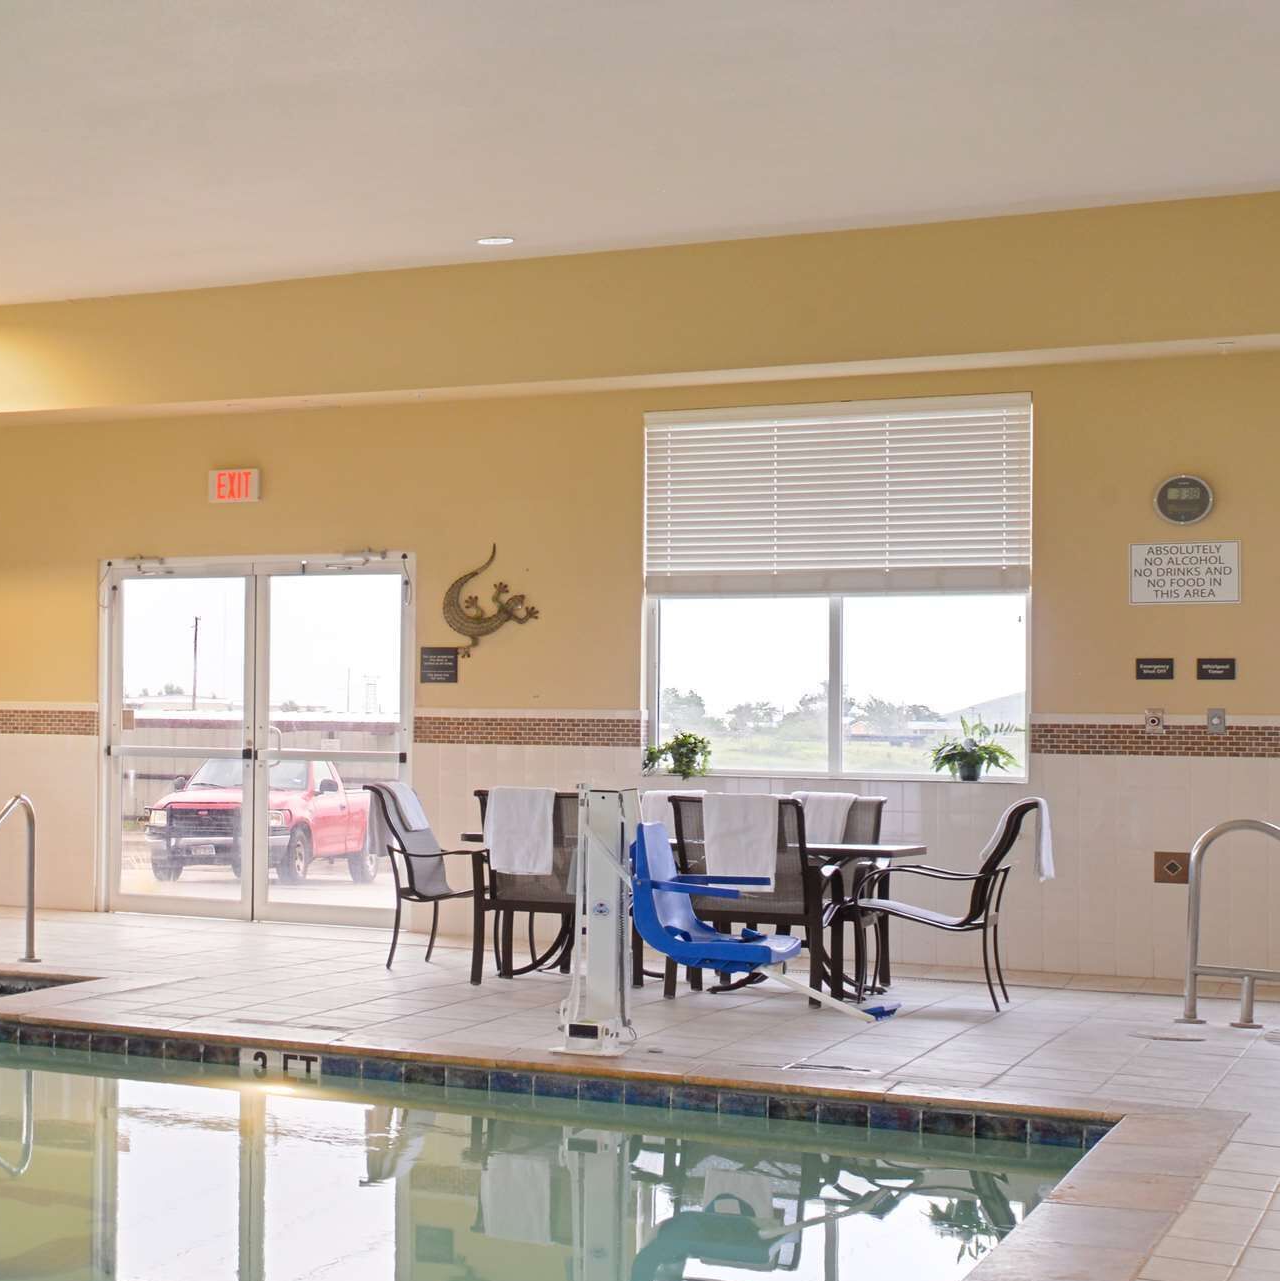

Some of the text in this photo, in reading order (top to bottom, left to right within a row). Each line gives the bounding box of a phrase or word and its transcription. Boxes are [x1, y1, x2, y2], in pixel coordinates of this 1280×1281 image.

[217, 471, 251, 499] EXIT
[1147, 545, 1222, 555] ABSOLUTELY
[1144, 555, 1225, 566] NO ALCOHOL
[1134, 566, 1232, 577] NO DRINKS AND
[1147, 578, 1222, 588] NO FOOD IN
[1154, 589, 1216, 599] THIS AREA
